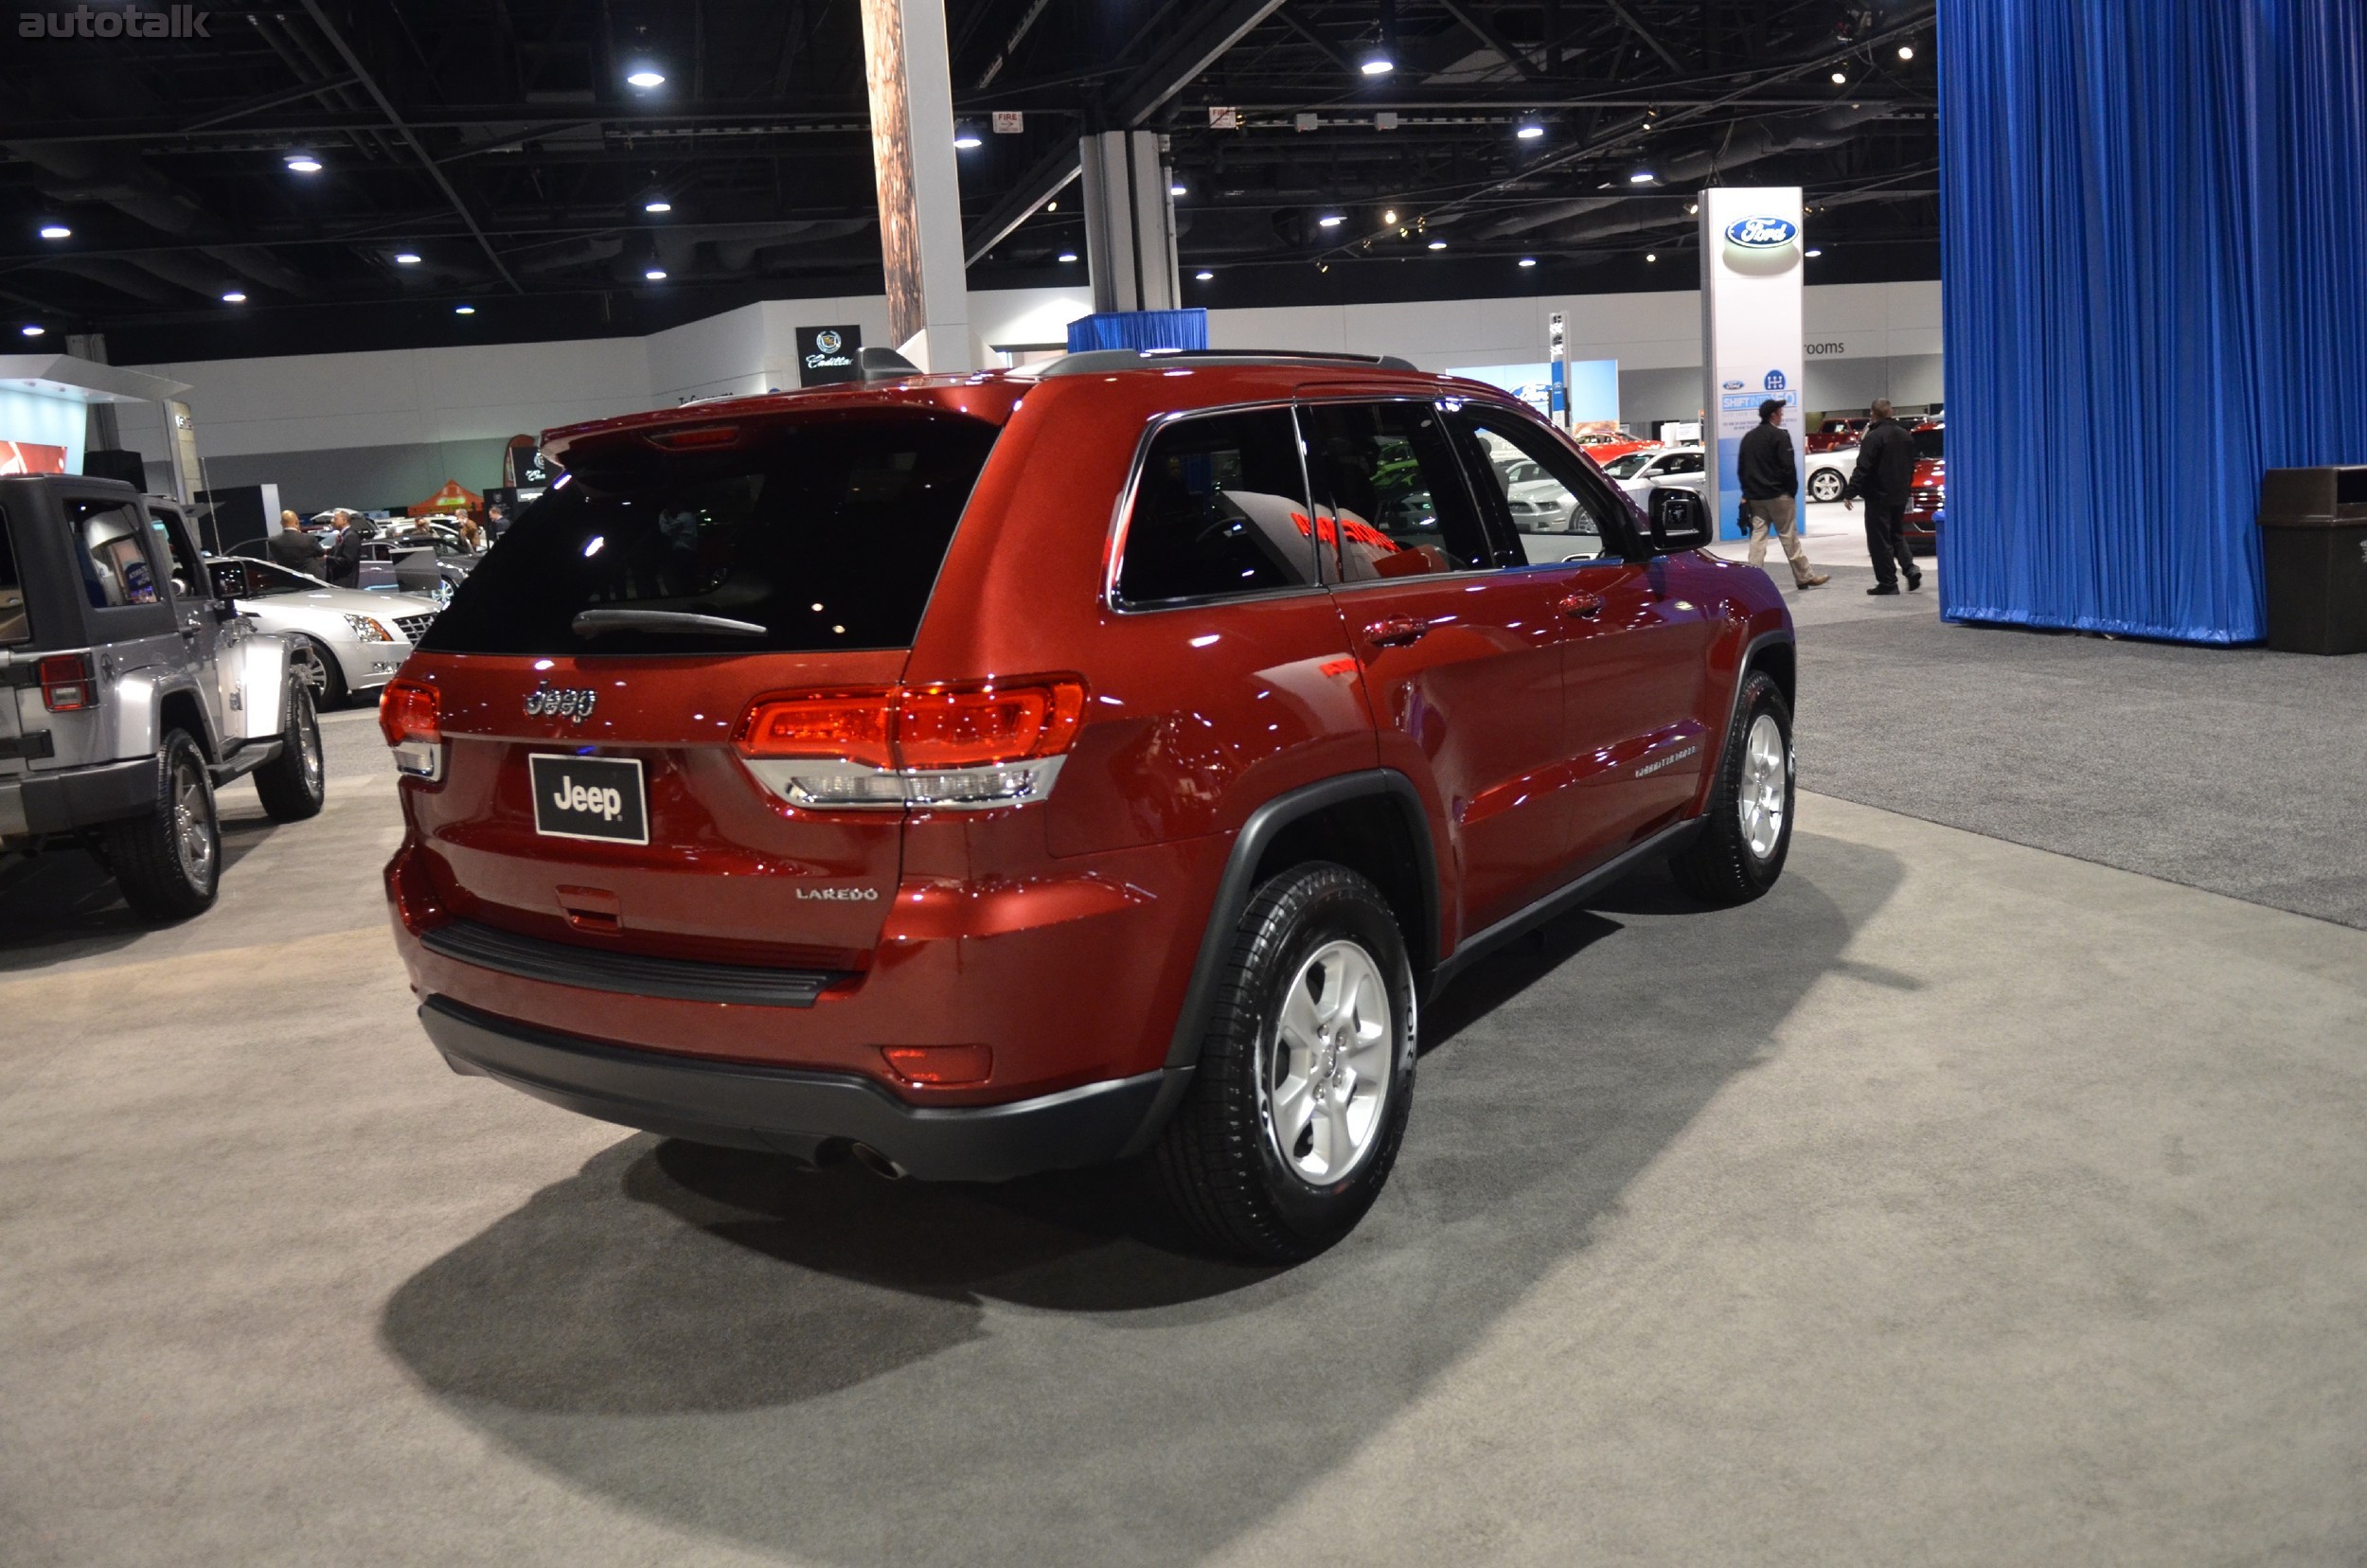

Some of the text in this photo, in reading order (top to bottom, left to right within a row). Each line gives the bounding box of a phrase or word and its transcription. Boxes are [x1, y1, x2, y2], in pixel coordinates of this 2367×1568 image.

[998, 113, 1018, 121] FIRE
[1740, 219, 1788, 242] Ford
[526, 681, 596, 723] Jeep
[553, 775, 622, 821] Jeep
[796, 888, 879, 900] LAREDO
